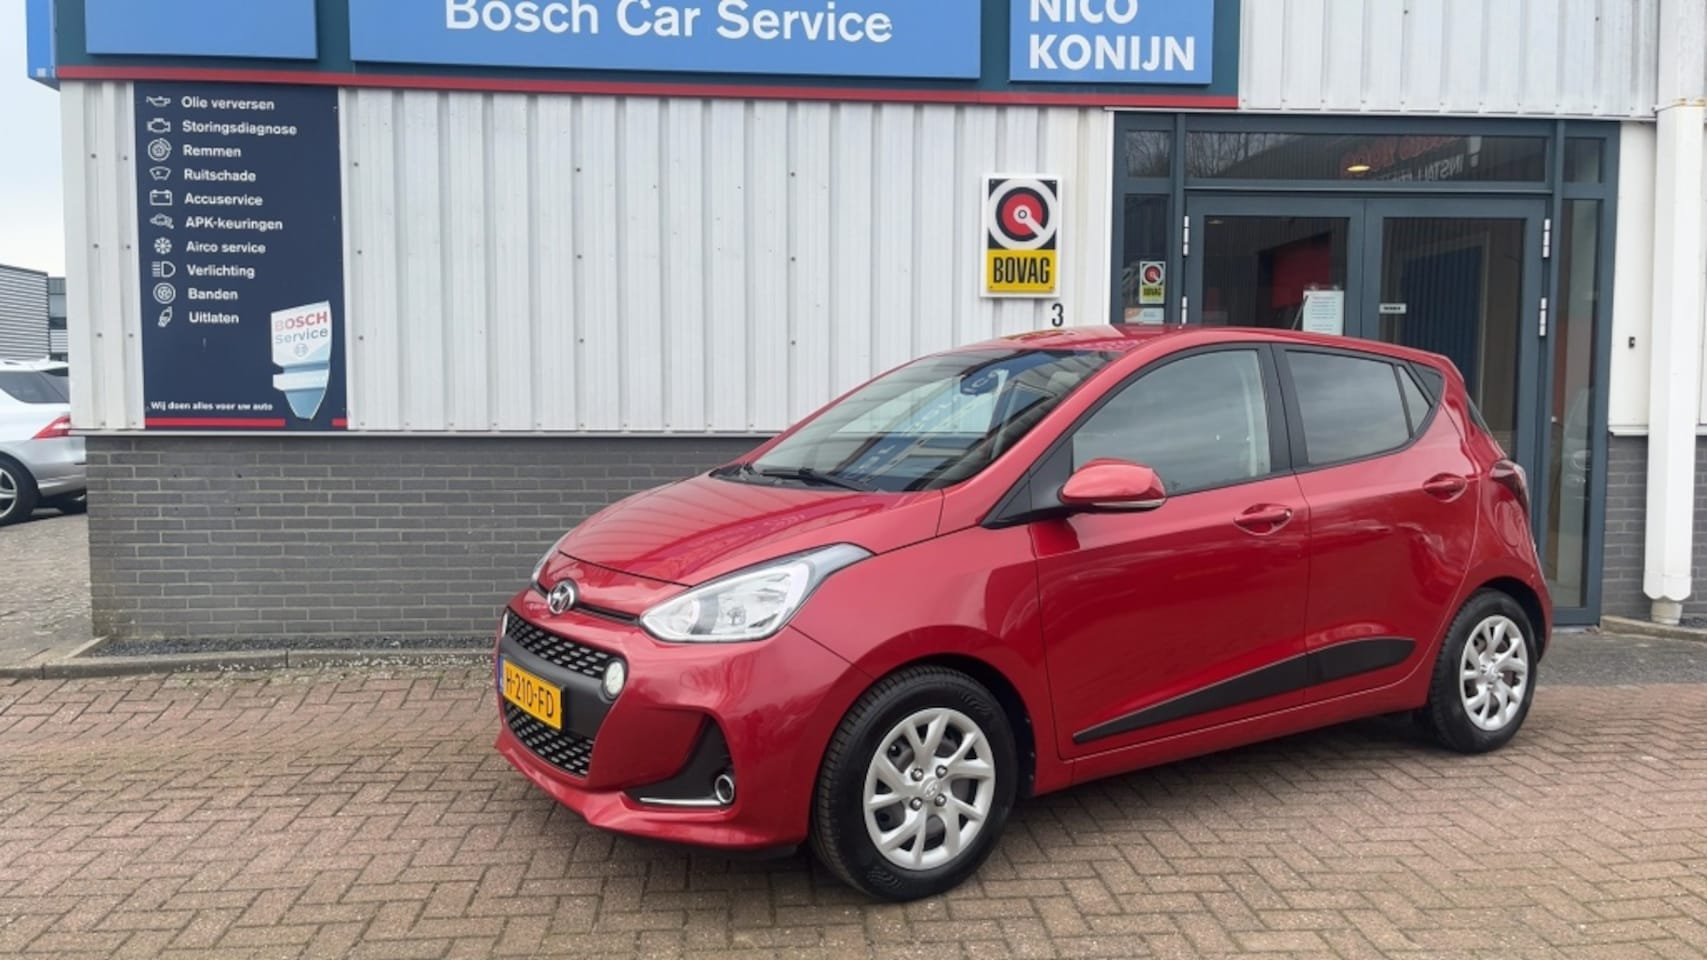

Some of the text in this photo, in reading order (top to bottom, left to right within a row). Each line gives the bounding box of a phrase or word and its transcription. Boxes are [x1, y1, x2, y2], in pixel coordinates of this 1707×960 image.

[1029, 0, 1139, 25] NICO
[445, 0, 893, 43] Bosch Car Service
[1029, 33, 1195, 72] KONIJN
[181, 95, 275, 111] Olie verversen
[182, 119, 298, 136] Storingsdiagnose
[183, 144, 242, 158] Remmen
[184, 168, 257, 182] Ruitschade
[184, 192, 264, 206] Accuservice
[185, 215, 284, 232] APK-keuringen
[186, 240, 267, 254] Airco service
[186, 263, 256, 279] Verlichting
[992, 256, 1051, 285] BOVAG
[187, 287, 239, 300] Banden
[188, 311, 240, 324] Uitlaten
[274, 311, 328, 332] BOSCH
[1051, 302, 1064, 327] 3
[275, 327, 329, 344] Service
[150, 401, 274, 412] Wij doen alles voor uw auto
[506, 667, 555, 718] H-210-FD
